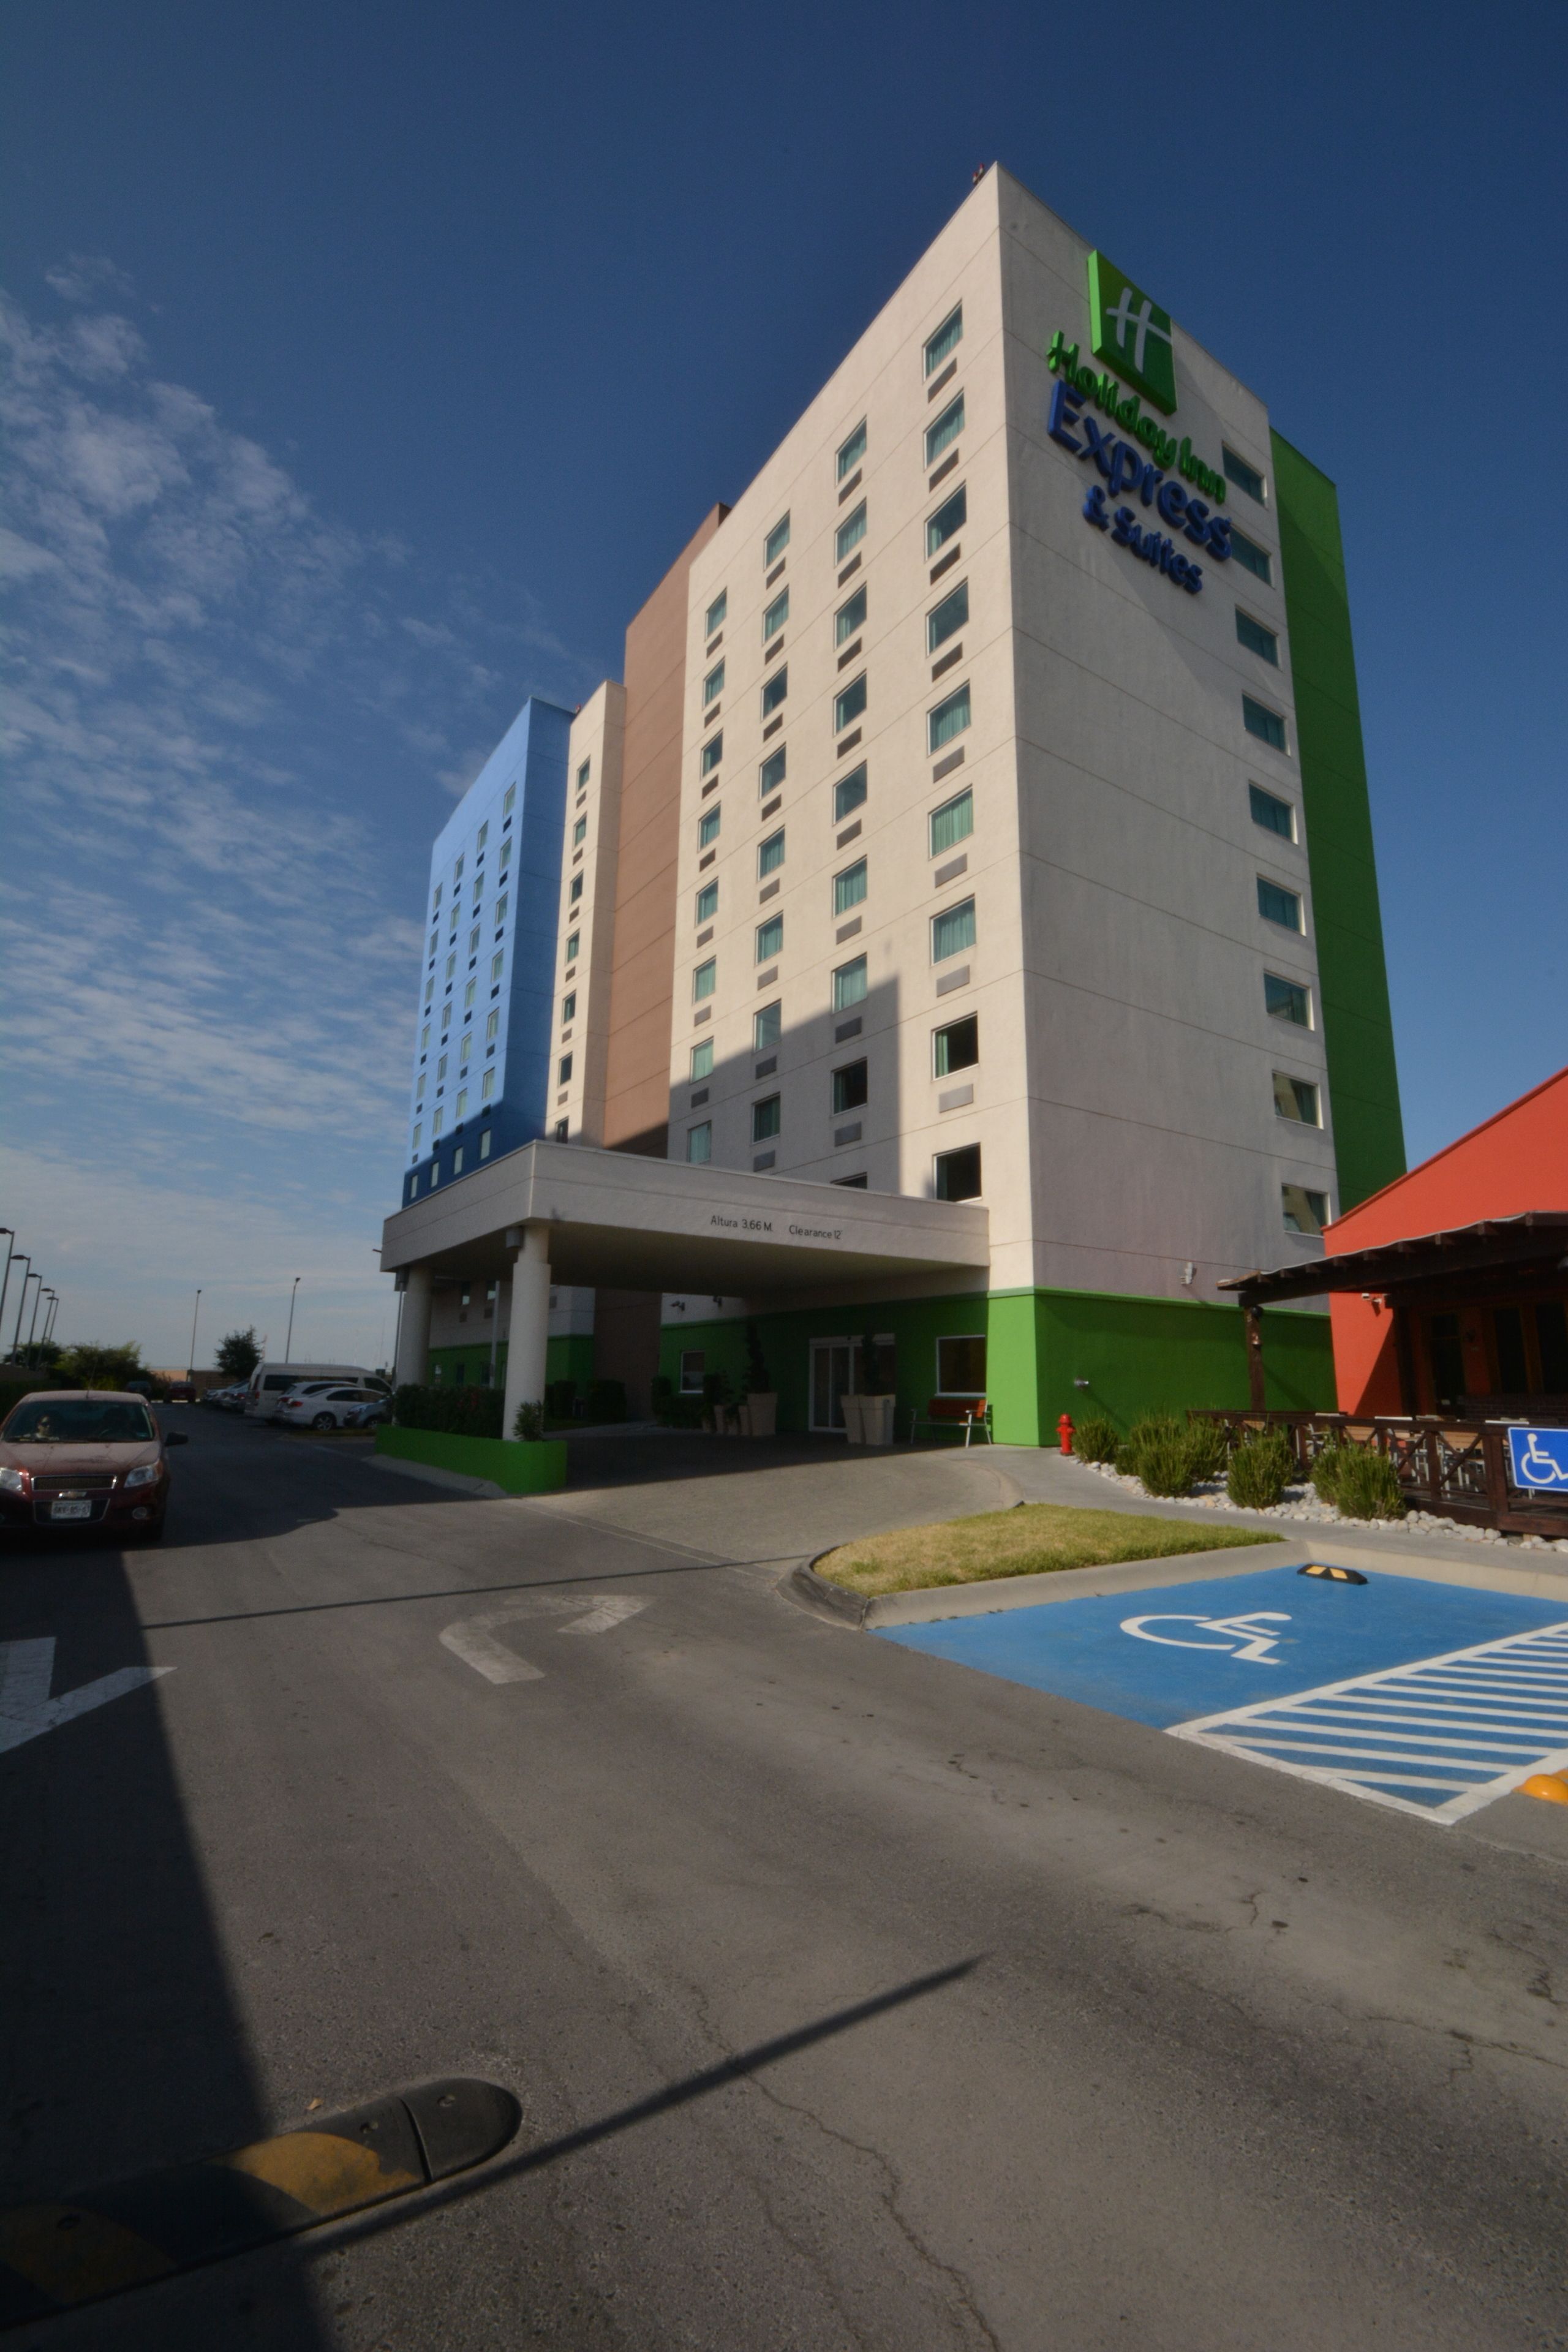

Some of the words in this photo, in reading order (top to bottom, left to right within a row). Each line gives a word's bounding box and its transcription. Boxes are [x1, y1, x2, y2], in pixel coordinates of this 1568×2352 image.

[1046, 330, 1178, 470] Holiday
[1180, 435, 1226, 505] Inn
[1047, 379, 1232, 562] Express
[1082, 484, 1110, 531] &
[1111, 506, 1203, 595] Suites
[710, 1215, 738, 1228] Altura
[742, 1218, 762, 1231] 3.66
[788, 1224, 832, 1239] Clearance
